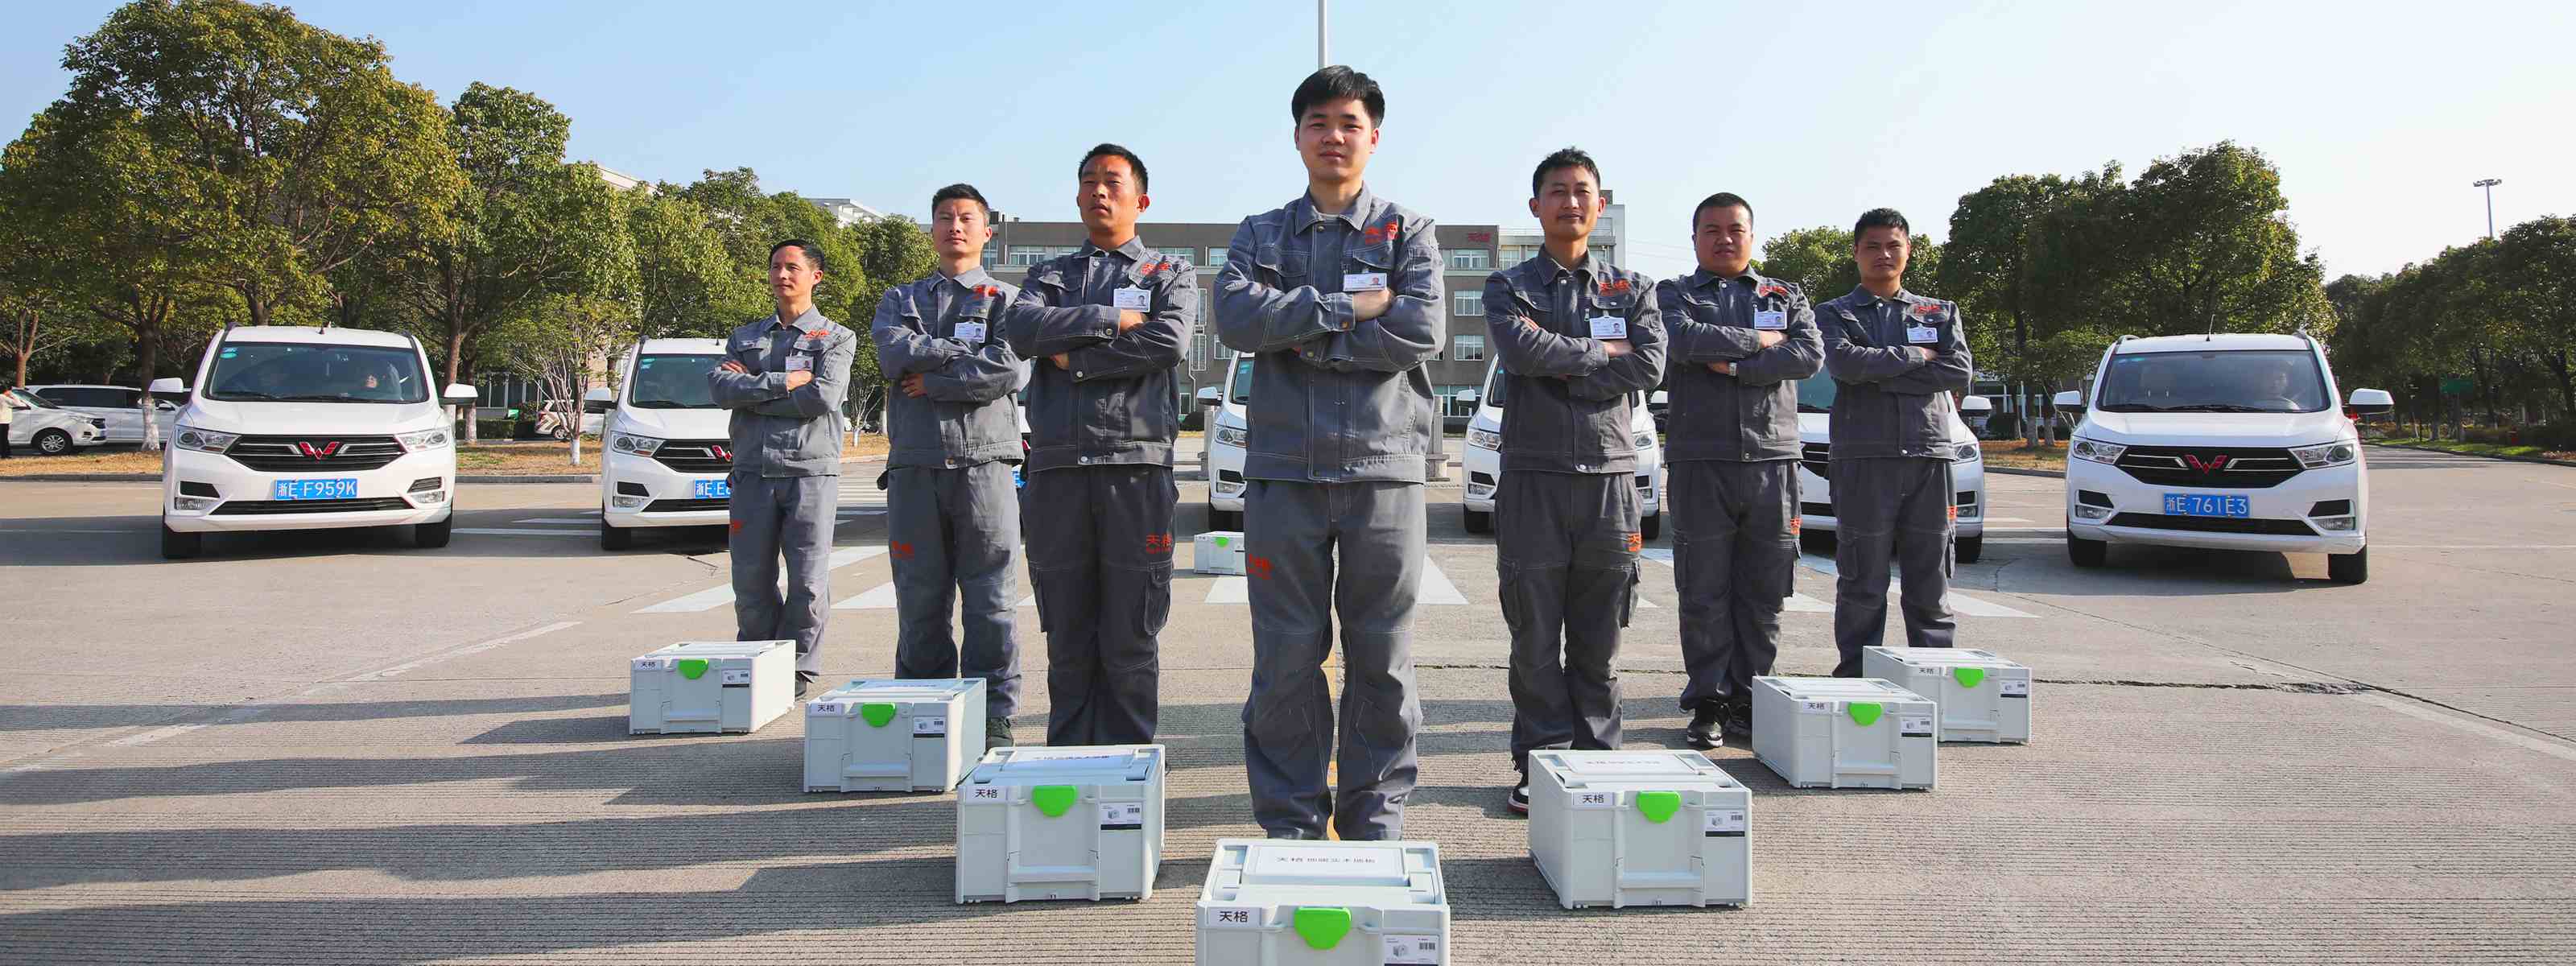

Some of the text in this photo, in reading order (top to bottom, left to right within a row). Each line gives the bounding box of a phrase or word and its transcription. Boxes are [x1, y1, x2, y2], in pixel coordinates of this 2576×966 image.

[817, 704, 835, 712] 天格
[975, 789, 998, 798] 天格
[1582, 795, 1604, 803] 天格
[1219, 910, 1249, 923] 天格
